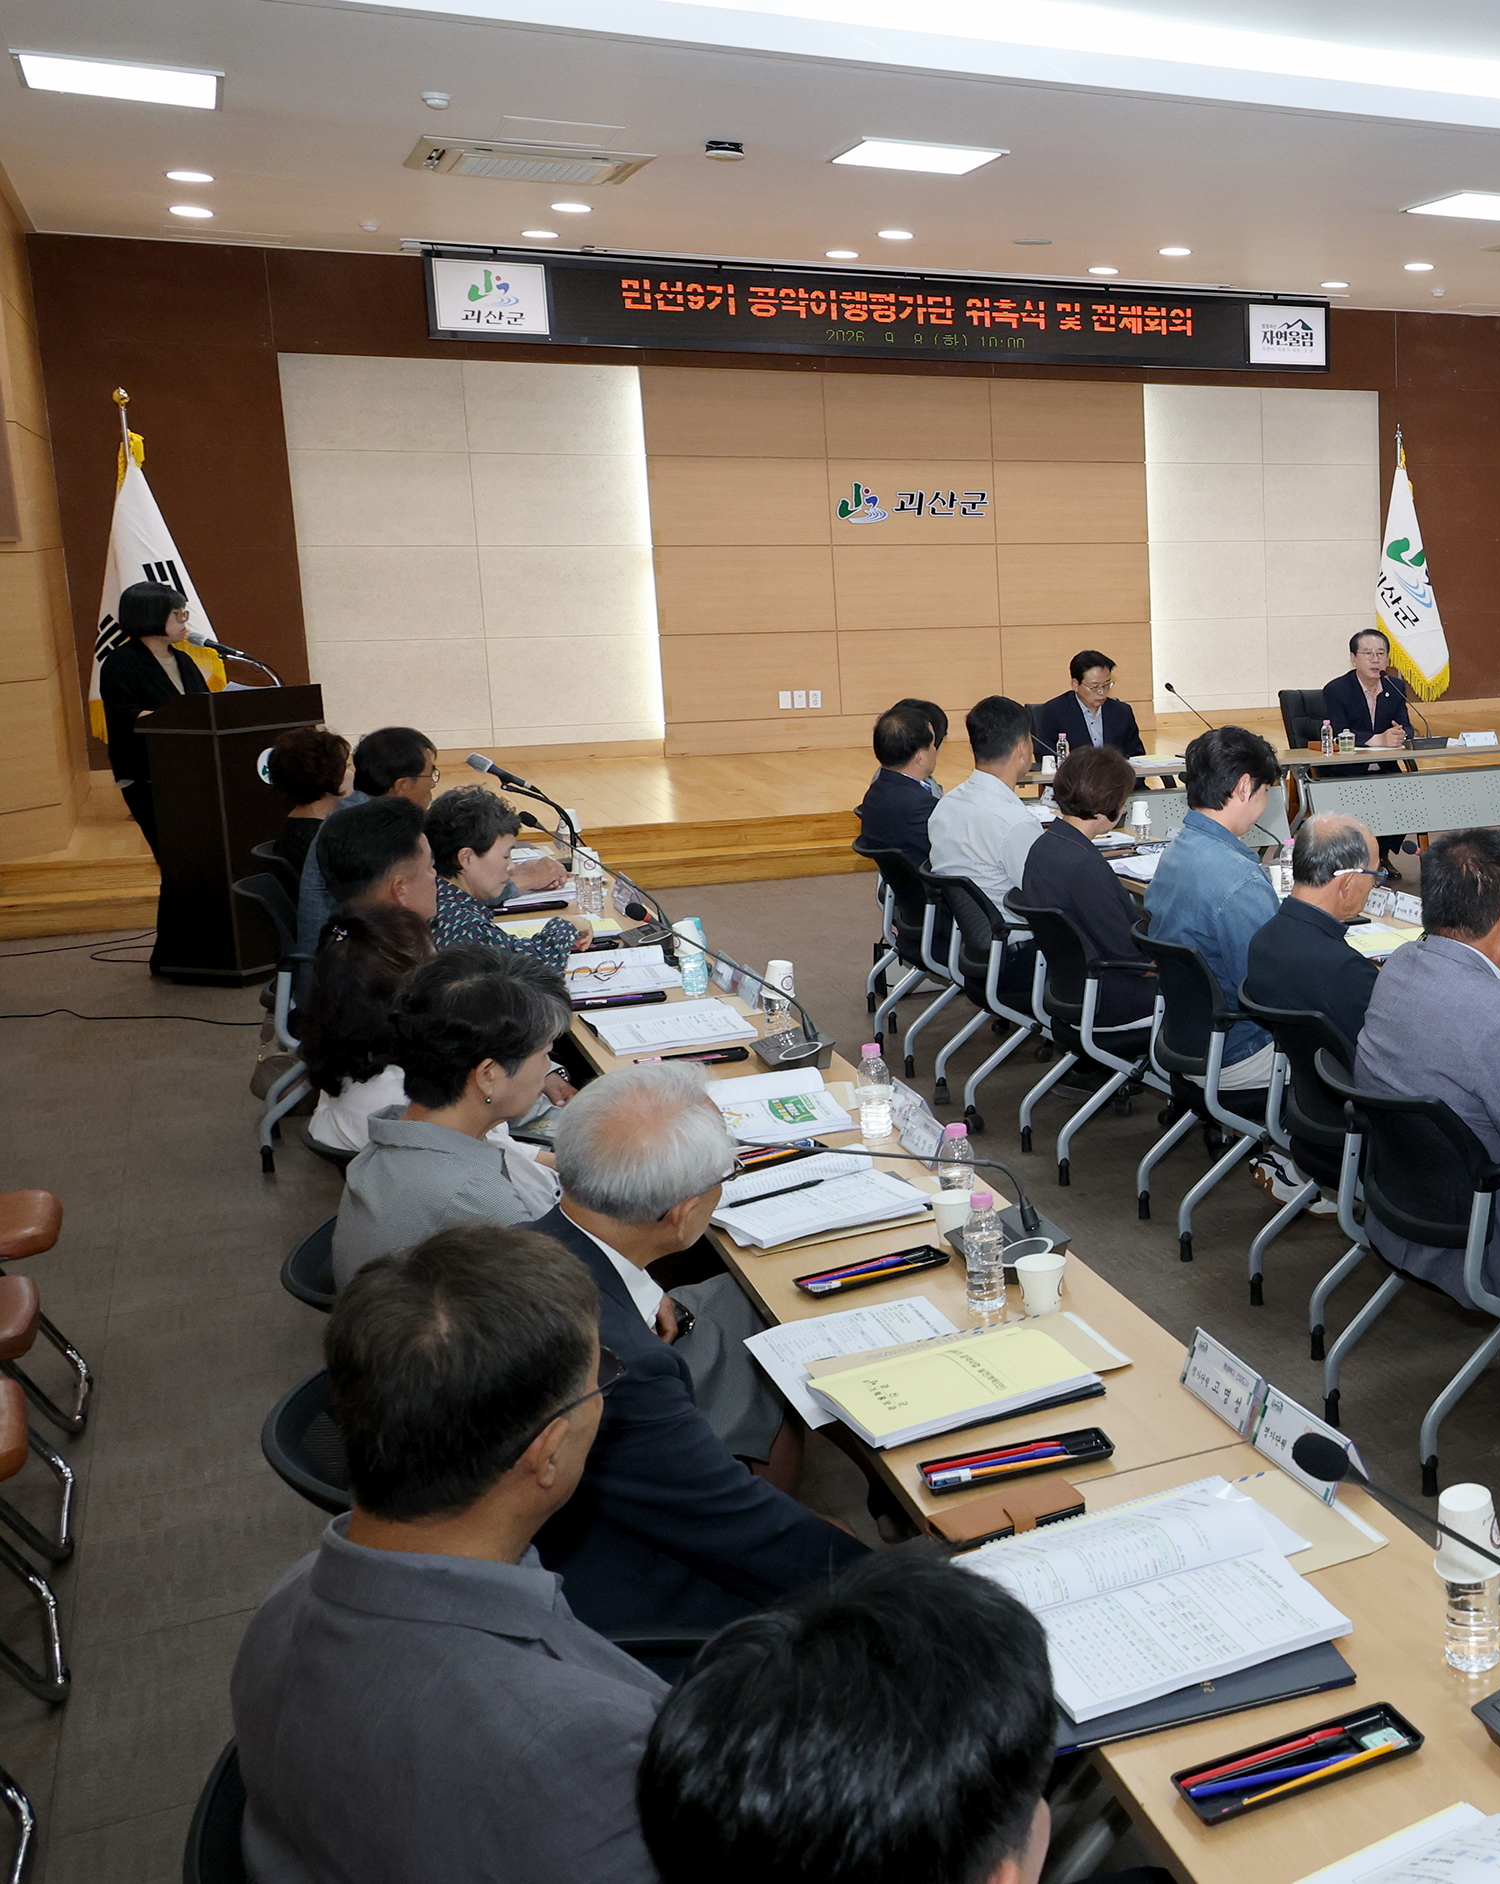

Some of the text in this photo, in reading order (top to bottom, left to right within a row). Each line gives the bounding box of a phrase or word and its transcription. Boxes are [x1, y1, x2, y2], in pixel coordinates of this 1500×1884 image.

[461, 309, 525, 326] 괴산군
[620, 278, 1194, 337] 민선9기 공약이행평가단 위촉식 및 전체회의
[1261, 329, 1314, 348] 자연울림
[893, 490, 988, 517] 괴산군
[1263, 1426, 1287, 1451] 평가단원
